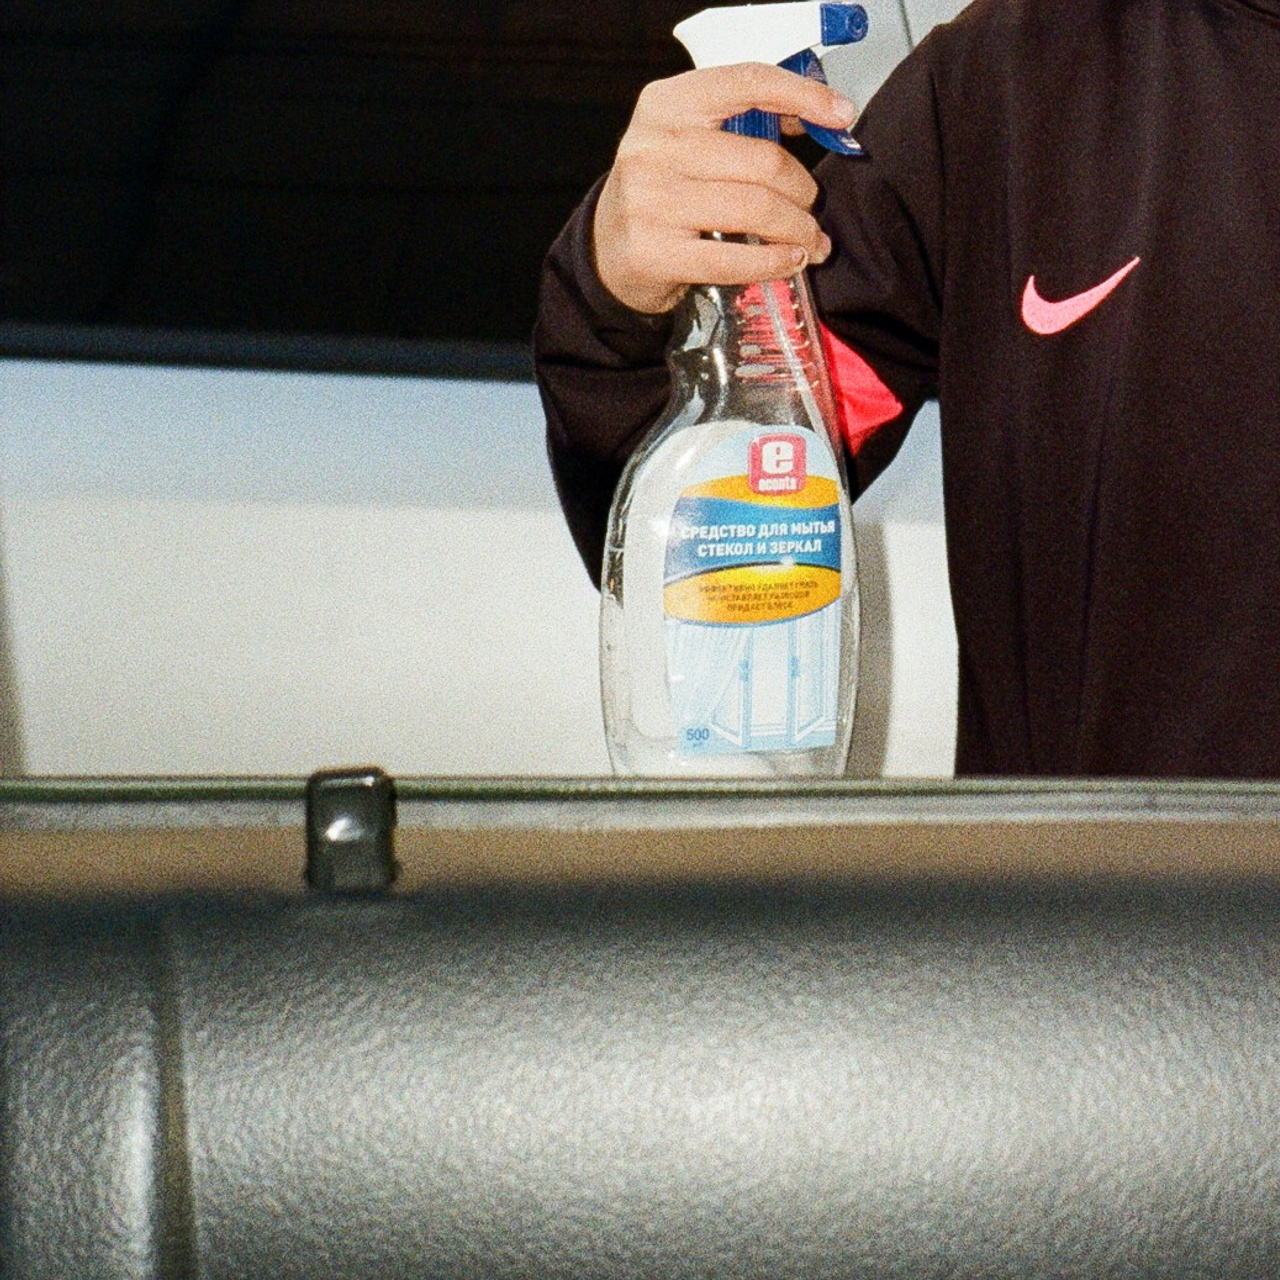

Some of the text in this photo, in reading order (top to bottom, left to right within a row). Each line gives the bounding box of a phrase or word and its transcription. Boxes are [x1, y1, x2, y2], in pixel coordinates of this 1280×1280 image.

[763, 440, 794, 475] e
[681, 520, 835, 540] СРЕДСТВО ДЛЯ МЫТЬЯ
[697, 539, 822, 557] СТЕКОЛ И ЗЕРКАЛ
[686, 728, 710, 741] 500
